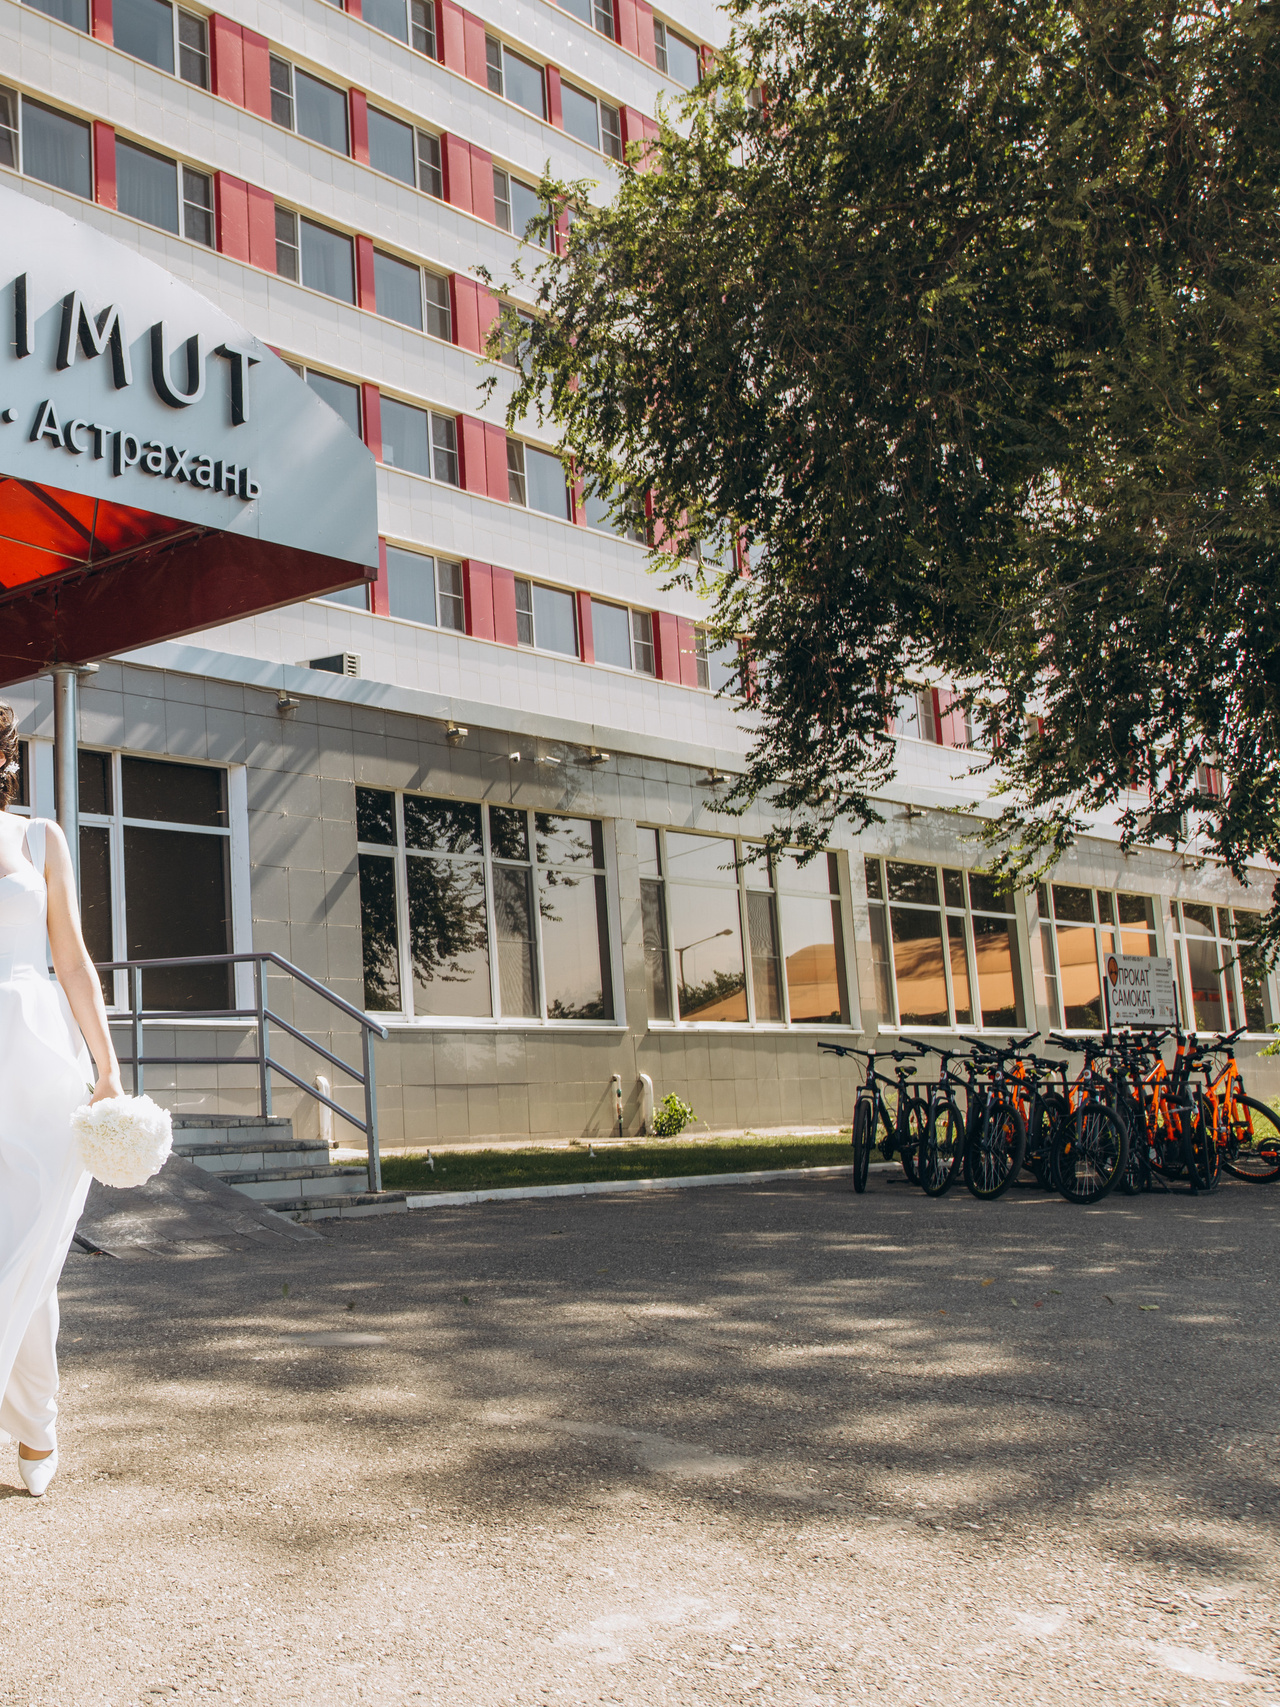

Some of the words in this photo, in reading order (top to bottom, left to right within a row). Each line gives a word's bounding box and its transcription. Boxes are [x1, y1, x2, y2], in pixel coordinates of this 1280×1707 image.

[29, 398, 262, 501] Астрахань
[1118, 968, 1149, 986] ПРОКАТ
[1112, 989, 1151, 1007] САМОКАТ
